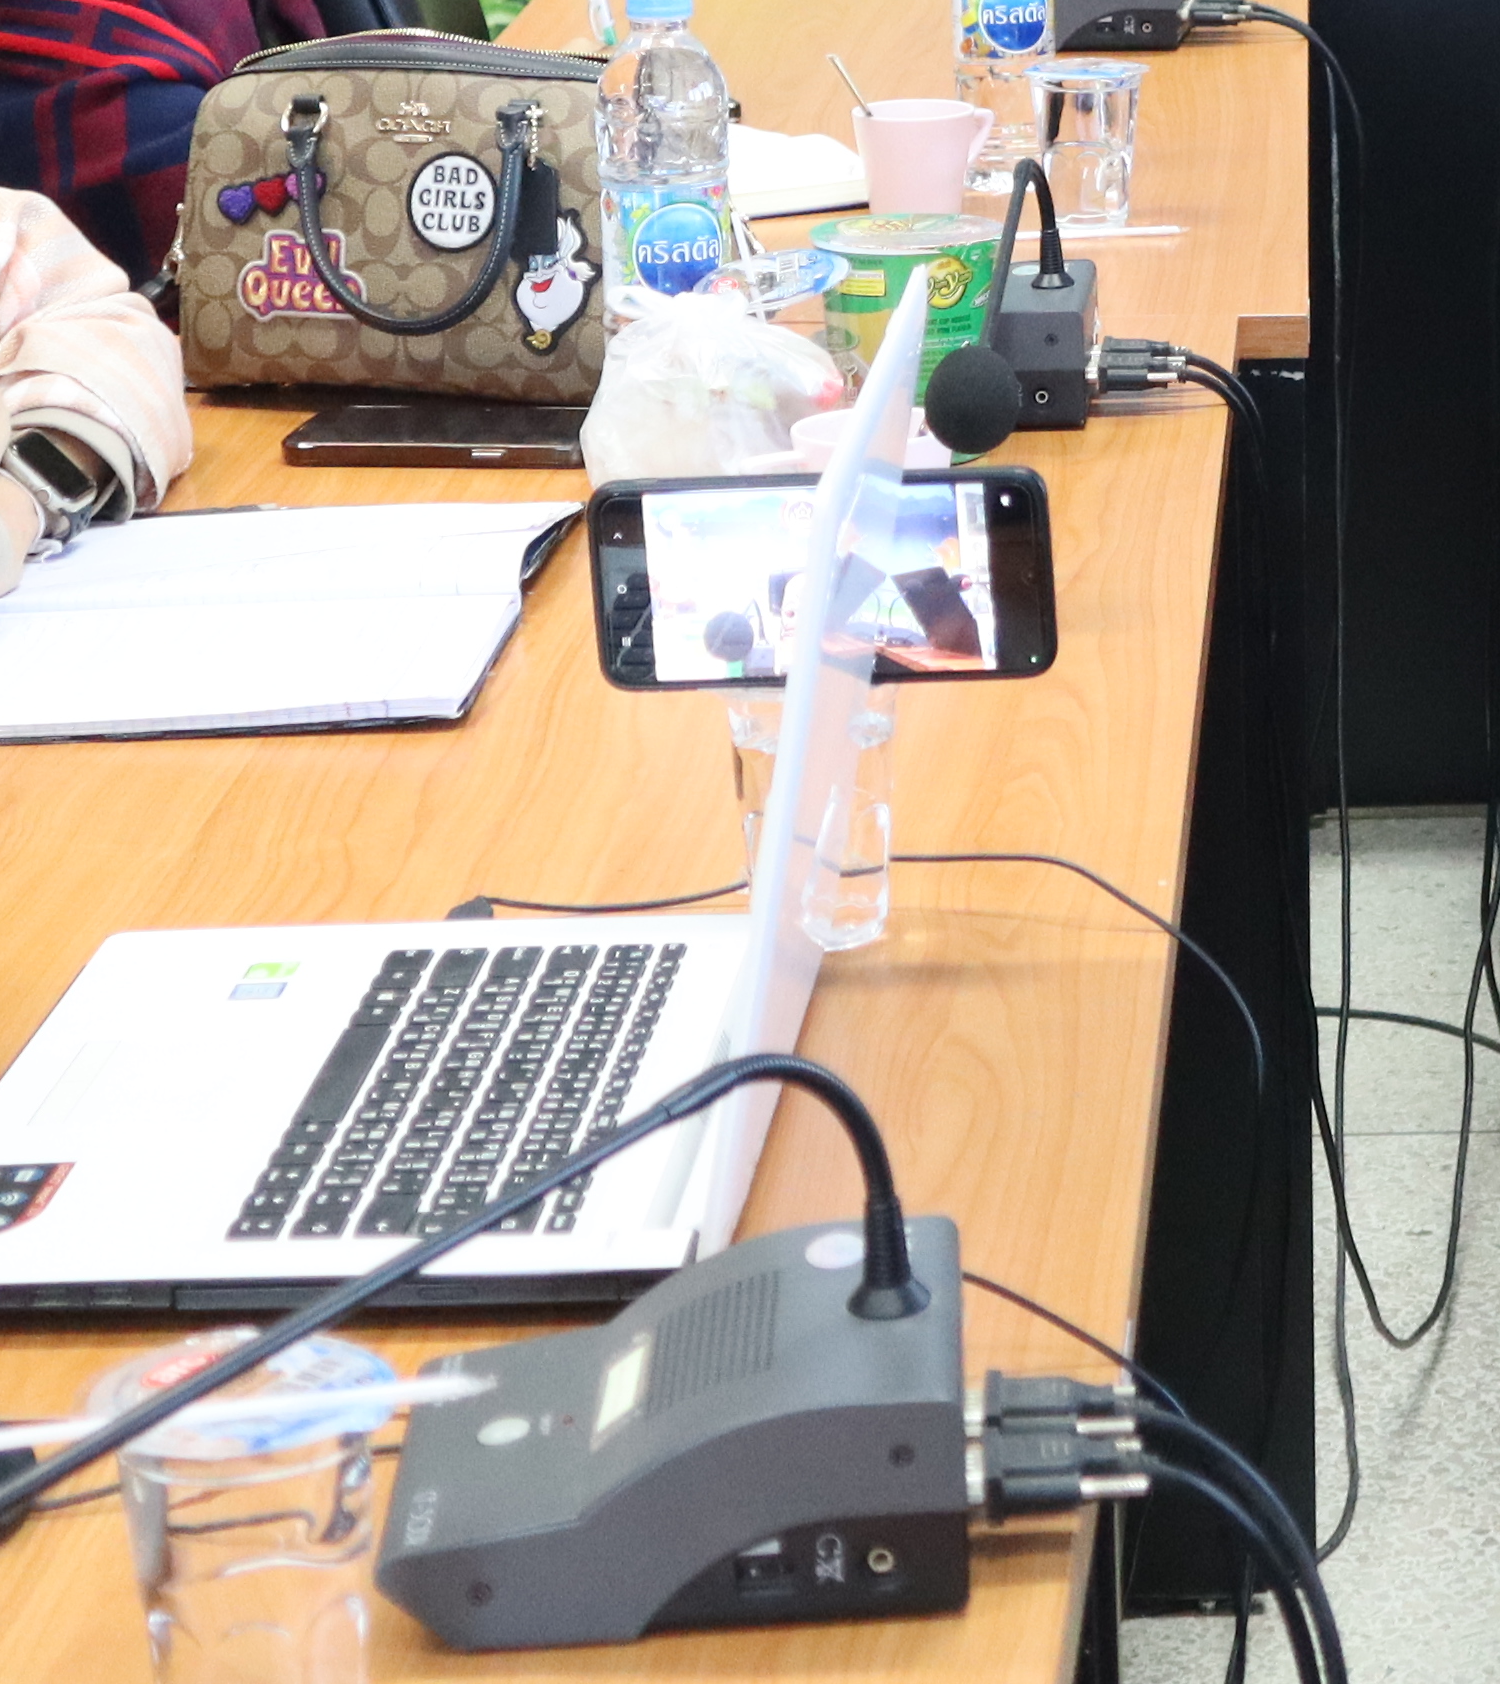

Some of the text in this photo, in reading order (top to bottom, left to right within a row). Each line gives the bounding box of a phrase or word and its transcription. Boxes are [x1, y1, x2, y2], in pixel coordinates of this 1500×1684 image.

[433, 165, 479, 185] BAD
[418, 188, 487, 212] GIRLS
[421, 212, 481, 234] CLUB
[243, 269, 361, 315] Quee
